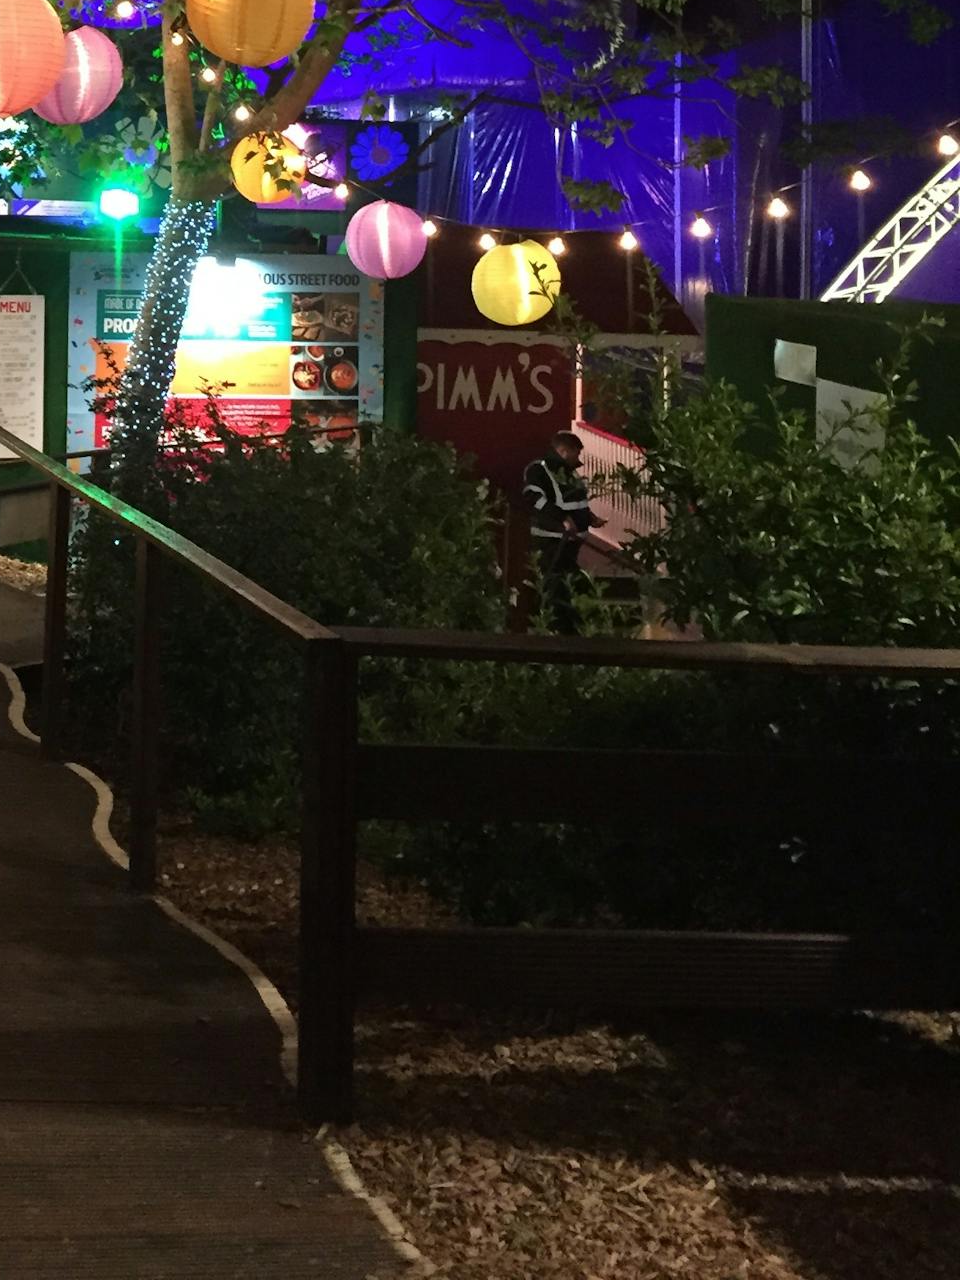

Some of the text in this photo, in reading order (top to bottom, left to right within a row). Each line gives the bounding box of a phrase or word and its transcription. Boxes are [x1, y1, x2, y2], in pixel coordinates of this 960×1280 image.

[288, 272, 326, 286] STREET
[329, 273, 360, 287] FOOD
[0, 301, 32, 313] MENU
